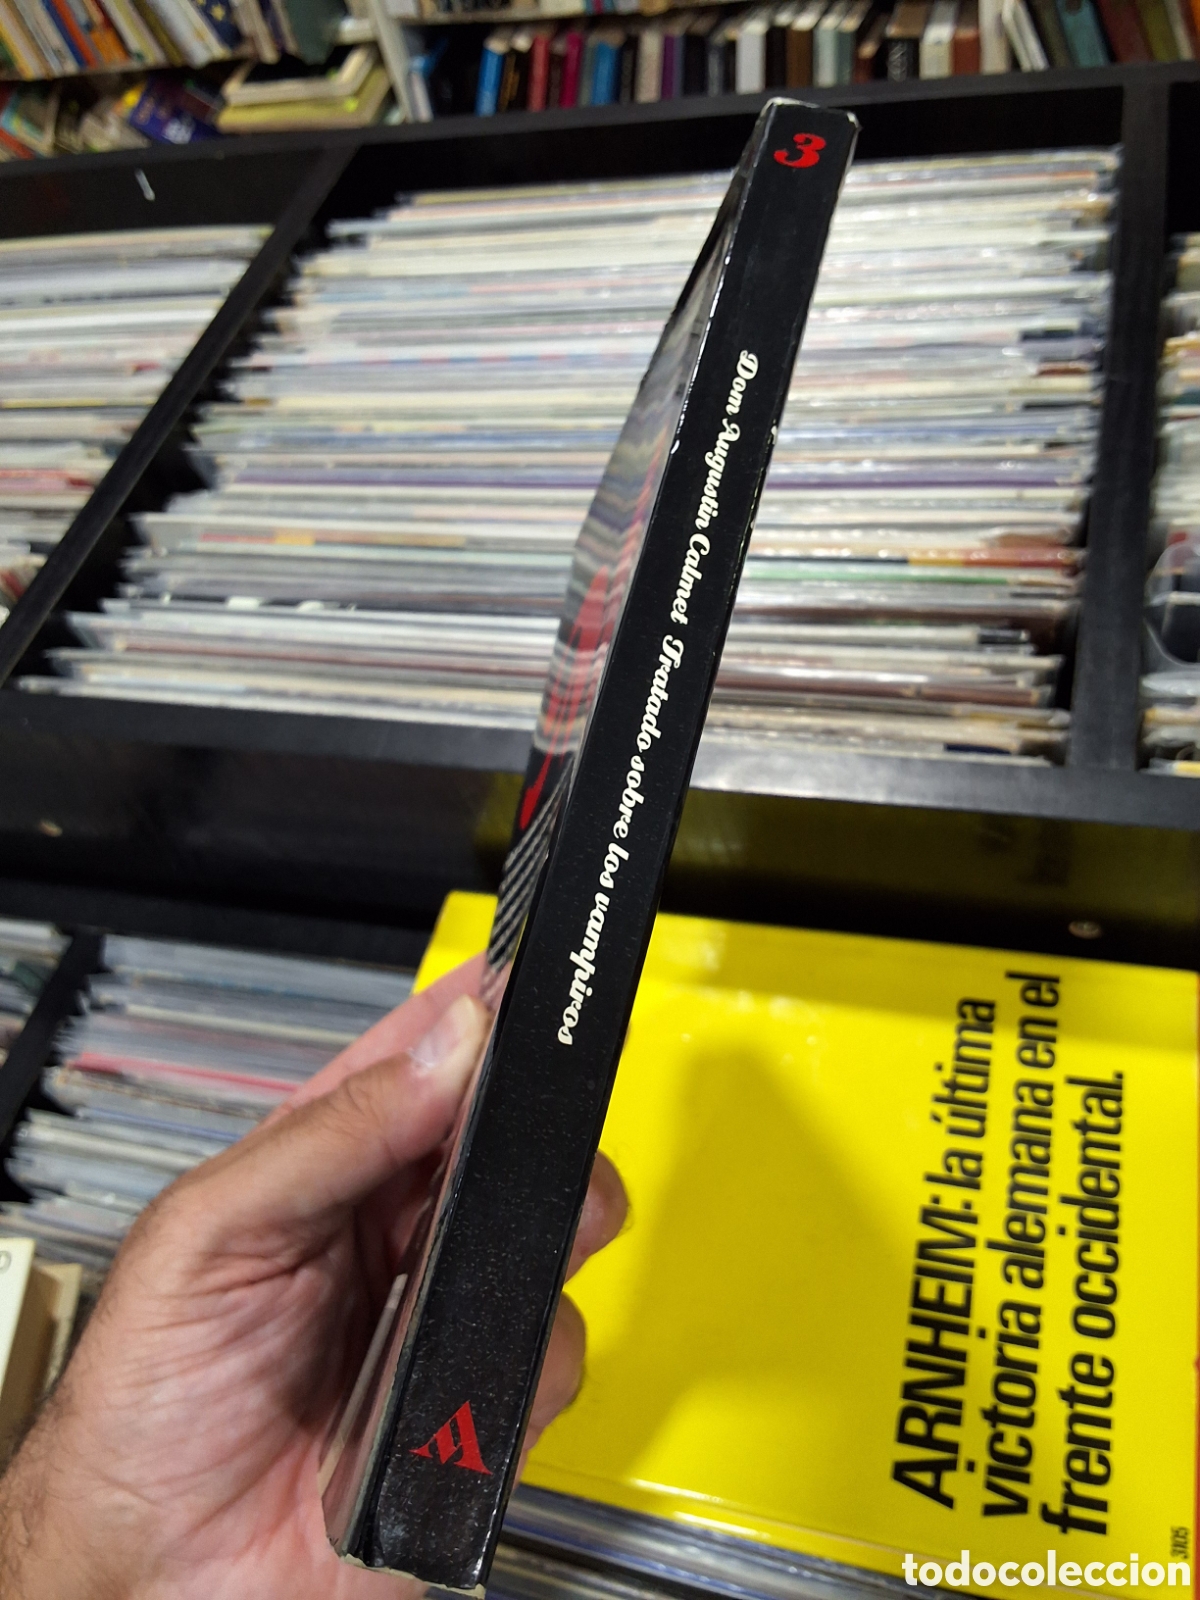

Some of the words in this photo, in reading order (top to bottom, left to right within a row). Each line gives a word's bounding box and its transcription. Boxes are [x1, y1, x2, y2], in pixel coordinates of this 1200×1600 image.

[773, 133, 826, 168] 3
[725, 349, 759, 416] Dom
[694, 418, 741, 530] Augustin
[670, 533, 711, 625] Calmet
[636, 634, 684, 753] Tratado
[613, 755, 645, 839] sobre
[599, 842, 630, 889] los
[557, 892, 610, 1045] vampiros
[1004, 970, 1062, 1010] el
[931, 998, 997, 1139] última
[1015, 1015, 1060, 1070] en
[924, 1149, 984, 1191] la
[986, 1080, 1055, 1290] alemana
[1057, 1072, 1125, 1340] occidental.
[891, 1197, 978, 1510] ARNHEIM:
[965, 1301, 1042, 1518] victoria
[1039, 1352, 1115, 1537] frente
